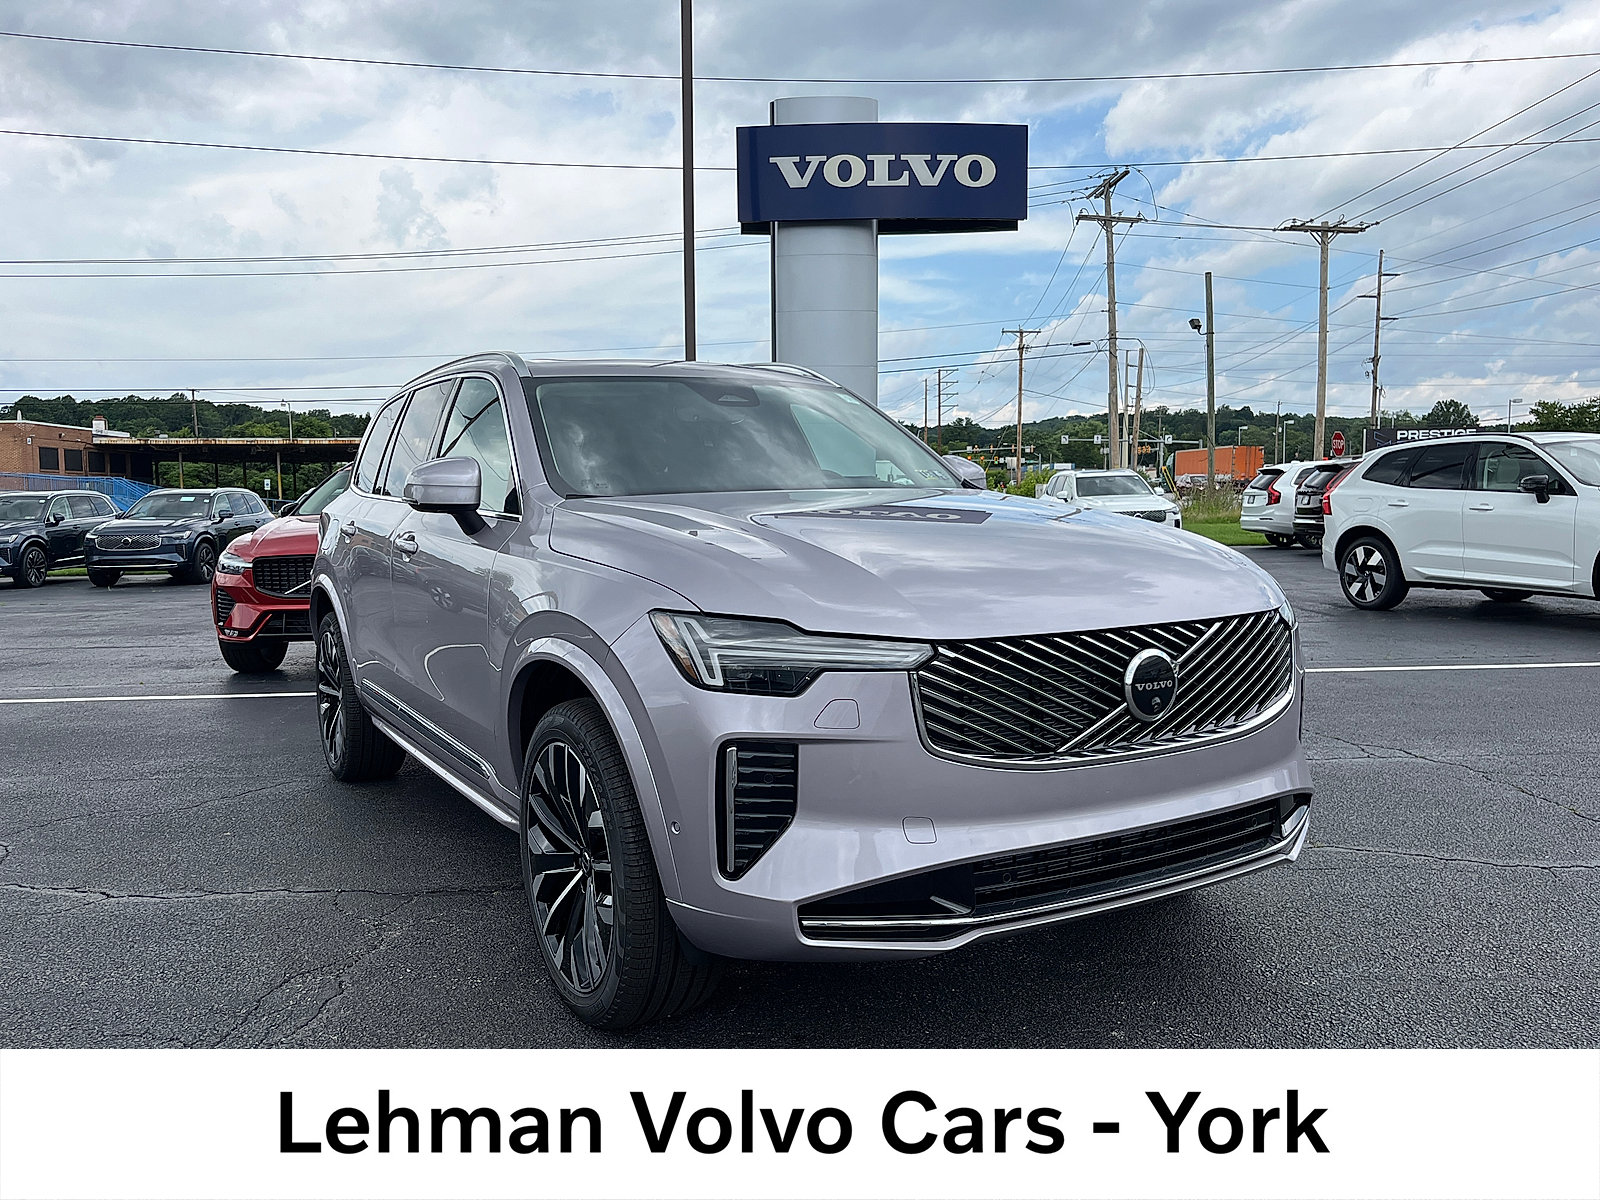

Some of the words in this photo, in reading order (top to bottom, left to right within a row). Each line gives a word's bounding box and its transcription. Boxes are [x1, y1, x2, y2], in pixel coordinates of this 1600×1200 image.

[769, 154, 997, 188] VOLVO
[1333, 439, 1344, 449] STOP
[1135, 680, 1173, 691] VOLVO
